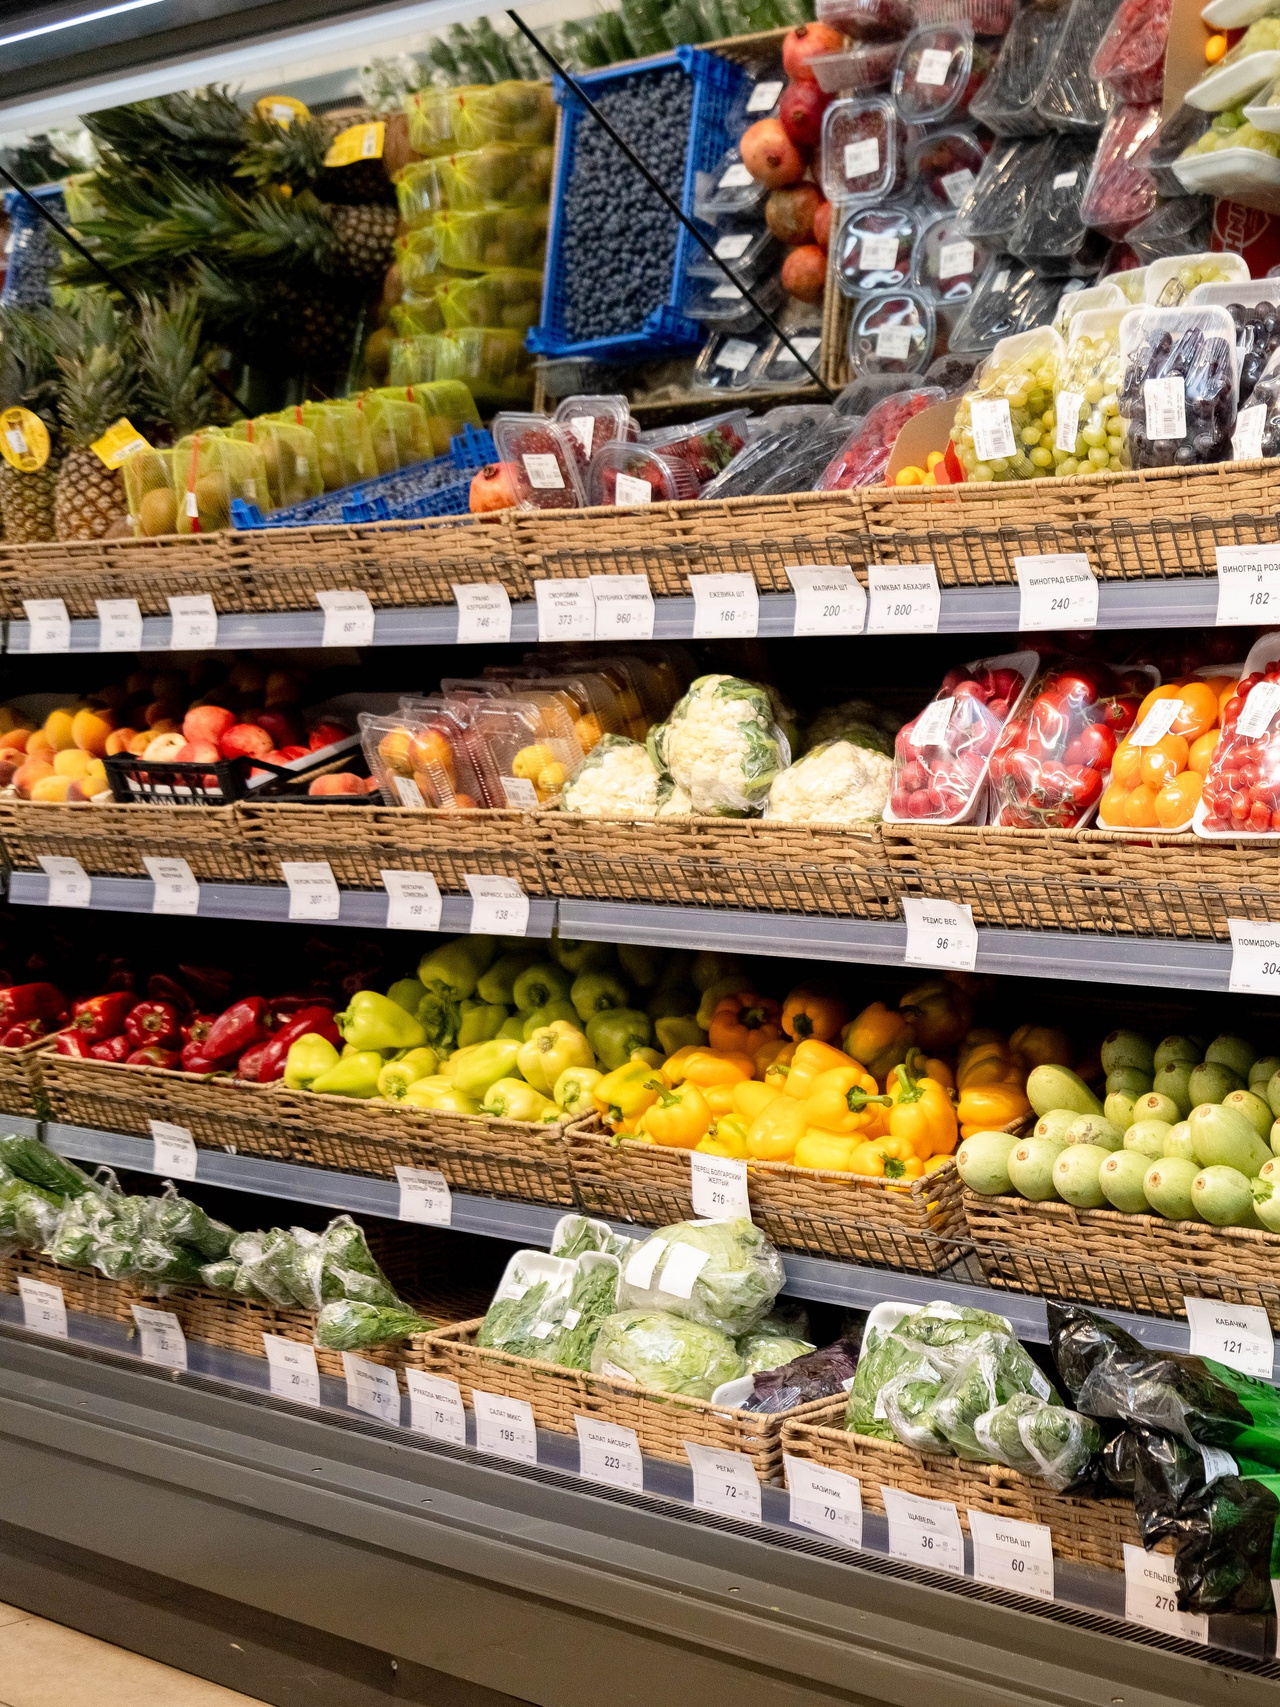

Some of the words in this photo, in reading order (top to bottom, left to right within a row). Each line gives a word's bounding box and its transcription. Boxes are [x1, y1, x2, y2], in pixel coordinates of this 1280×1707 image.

[1222, 564, 1262, 574] ВИНОГРАД
[1029, 576, 1064, 587] ВИНОГРАД
[1065, 573, 1090, 584] БЕЛЫЙ
[1257, 574, 1263, 582] Й
[812, 584, 838, 592] МАЛИНА
[838, 583, 848, 591] ШТ
[874, 584, 902, 592] КУМКВАТ
[903, 583, 932, 591] АБХАЗИЯ
[709, 591, 736, 599] ЕЖЕВИКА
[1249, 592, 1270, 605] 182
[894, 604, 912, 616] 800
[1050, 598, 1070, 611] 240
[720, 610, 736, 622] 166
[823, 605, 841, 617] 200
[557, 614, 573, 625] 373
[616, 613, 632, 624] 960
[494, 910, 509, 920] 138
[922, 916, 943, 925] РЕДИС
[944, 918, 958, 926] ВЕС
[936, 937, 949, 950] 96
[693, 1164, 711, 1175] ПЕРЕЦ
[424, 1198, 434, 1209] 79
[712, 1191, 726, 1205] 216
[1215, 1317, 1248, 1330] КАБАЧКИ
[1223, 1340, 1243, 1354] 121
[291, 1374, 301, 1386] 20
[372, 1391, 382, 1404] 75
[434, 1411, 445, 1423] 75
[488, 1406, 506, 1417] САЛАТ
[499, 1428, 515, 1442] 195
[588, 1432, 606, 1443] САЛАТ
[604, 1455, 620, 1470] 223
[715, 1463, 736, 1475] РЕГАН
[725, 1484, 737, 1498] 72
[810, 1482, 842, 1499] БАЗИЛИК
[823, 1506, 836, 1521] 70
[907, 1512, 937, 1527] ЩАВЕЛЬ
[921, 1535, 934, 1550] 36
[995, 1532, 1019, 1547] БОТВА
[1019, 1539, 1031, 1549] ШТ
[1011, 1558, 1025, 1574] 60
[1155, 1595, 1176, 1613] 276
